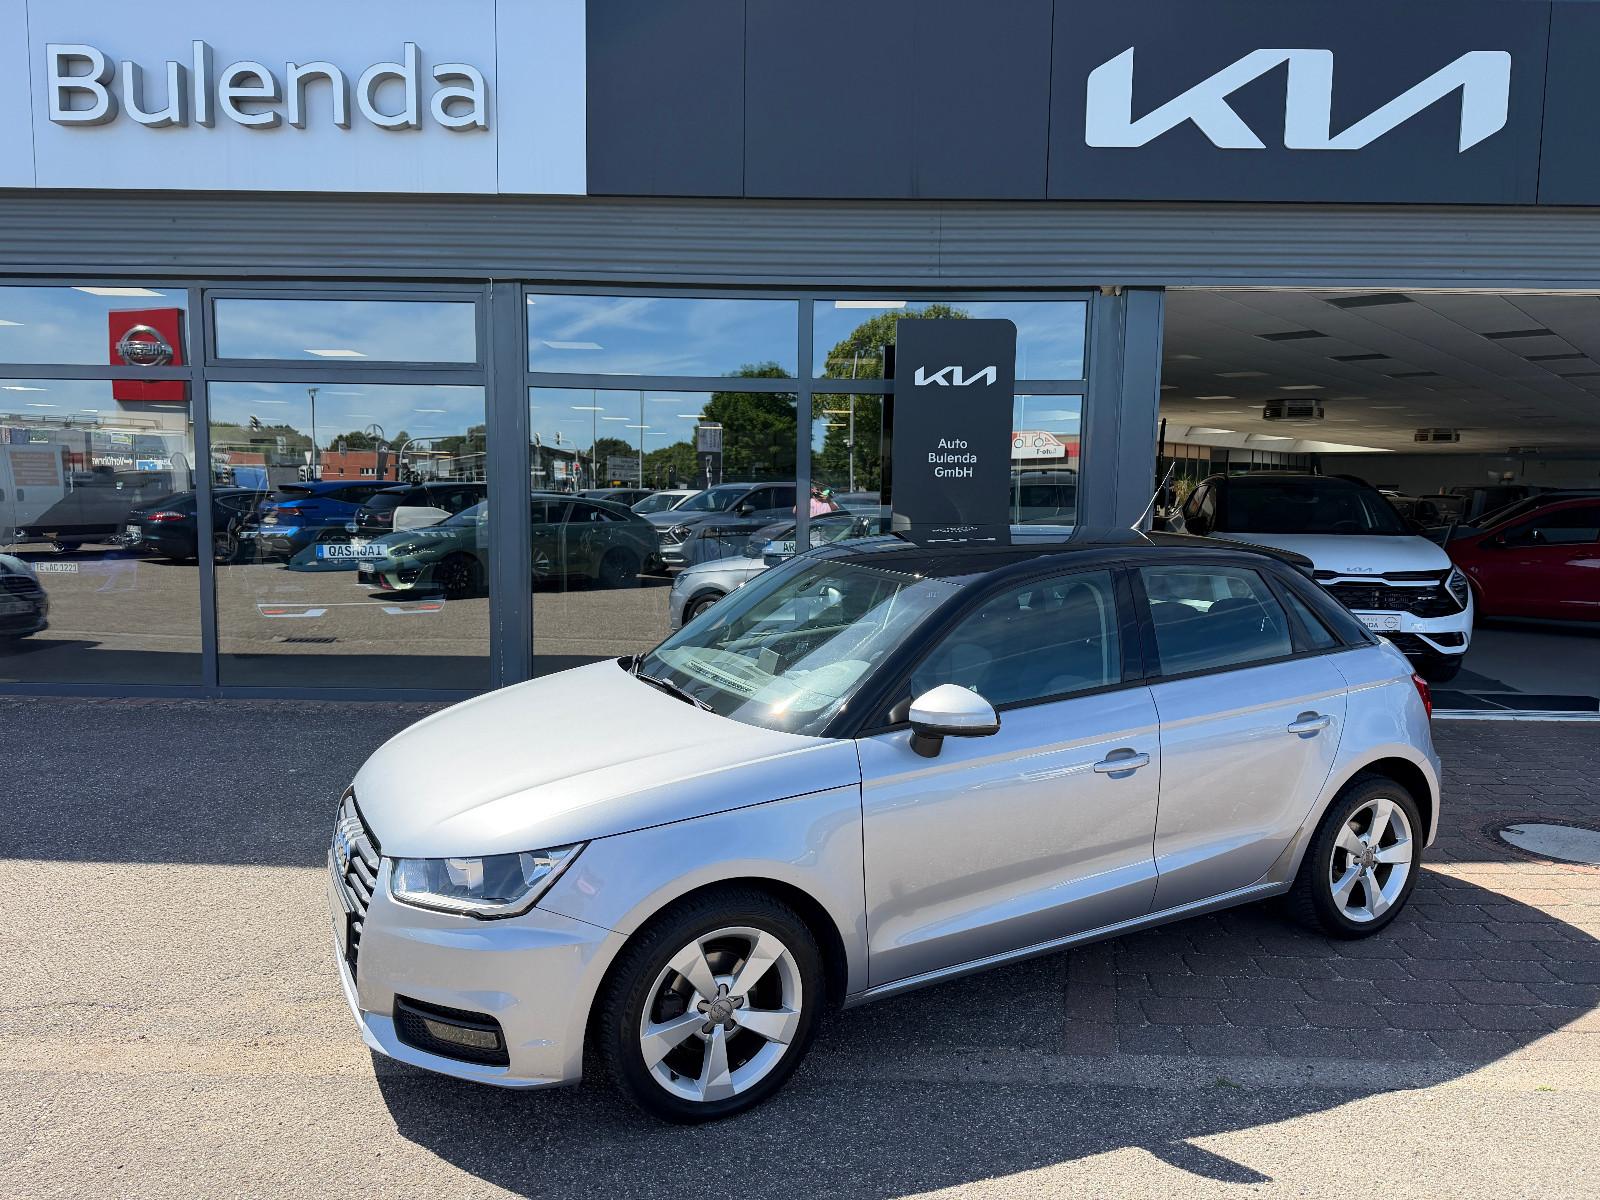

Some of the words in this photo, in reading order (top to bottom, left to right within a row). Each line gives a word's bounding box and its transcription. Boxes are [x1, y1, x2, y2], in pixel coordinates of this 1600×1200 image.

[46, 39, 489, 131] Bulenda
[1085, 46, 1512, 154] KIA
[914, 365, 997, 386] KIA
[937, 438, 968, 449] Auto
[928, 452, 977, 463] Bulenda
[934, 466, 973, 477] GmbH
